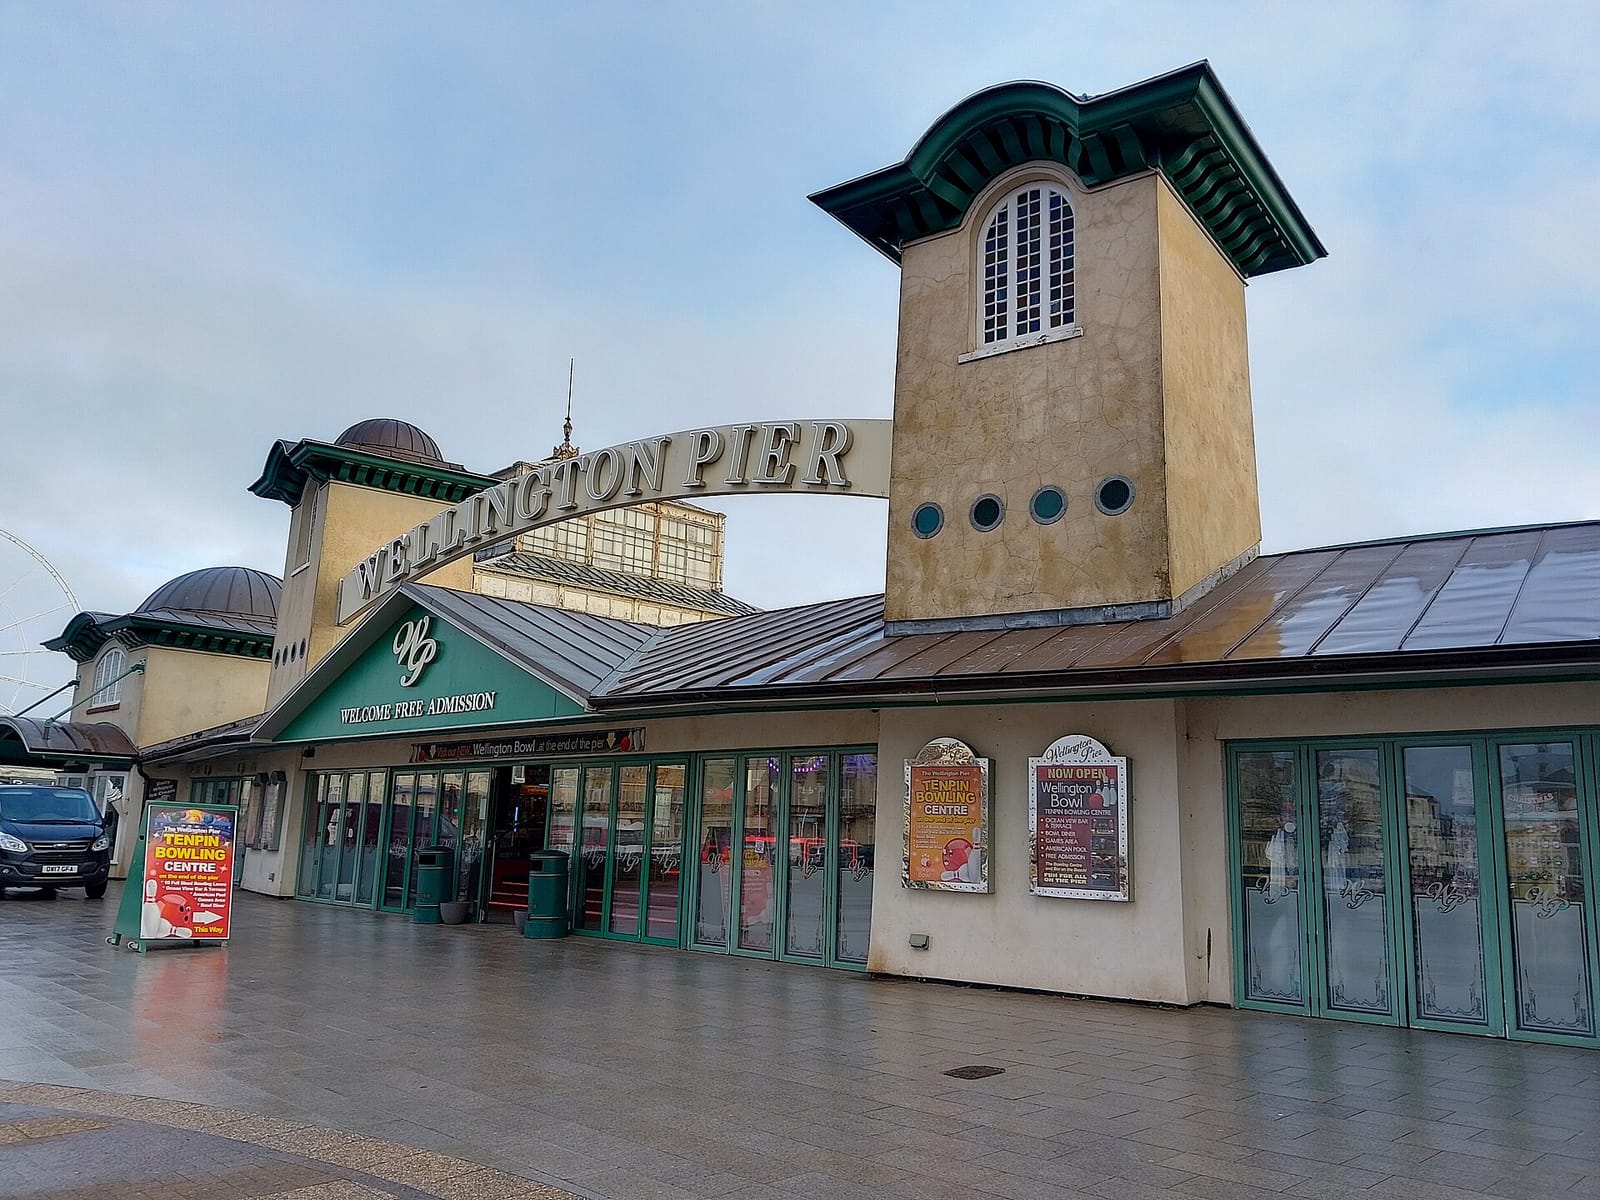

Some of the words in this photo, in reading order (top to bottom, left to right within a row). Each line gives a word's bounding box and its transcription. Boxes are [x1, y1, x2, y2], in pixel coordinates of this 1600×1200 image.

[353, 436, 672, 600] WELLINGTON
[682, 421, 854, 487] PIER
[341, 703, 391, 724] WELCOME
[394, 700, 424, 719] FREE
[427, 692, 496, 715] ADMISSION
[473, 743, 512, 757] Wellington
[514, 740, 536, 753] Bowl
[546, 739, 557, 751] the
[557, 738, 570, 750] end
[571, 738, 579, 749] of
[580, 737, 591, 749] the
[591, 736, 605, 752] pier
[1046, 739, 1092, 762] Wellington
[1081, 746, 1102, 763] Pier
[932, 771, 959, 779] Wellington
[1047, 768, 1073, 779] NOW
[1075, 768, 1106, 779] OPEN
[921, 779, 970, 791] TENPIN
[1041, 781, 1092, 797] Wellington
[916, 791, 976, 804] BOWLING
[1050, 794, 1083, 808] Bowl
[924, 804, 968, 815] CENTRE
[176, 827, 207, 835] Wellington
[163, 833, 219, 847] TENPIN
[155, 846, 226, 860] BOWLING
[164, 861, 216, 873] CENTRE
[194, 926, 208, 934] This
[209, 927, 224, 935] Way
